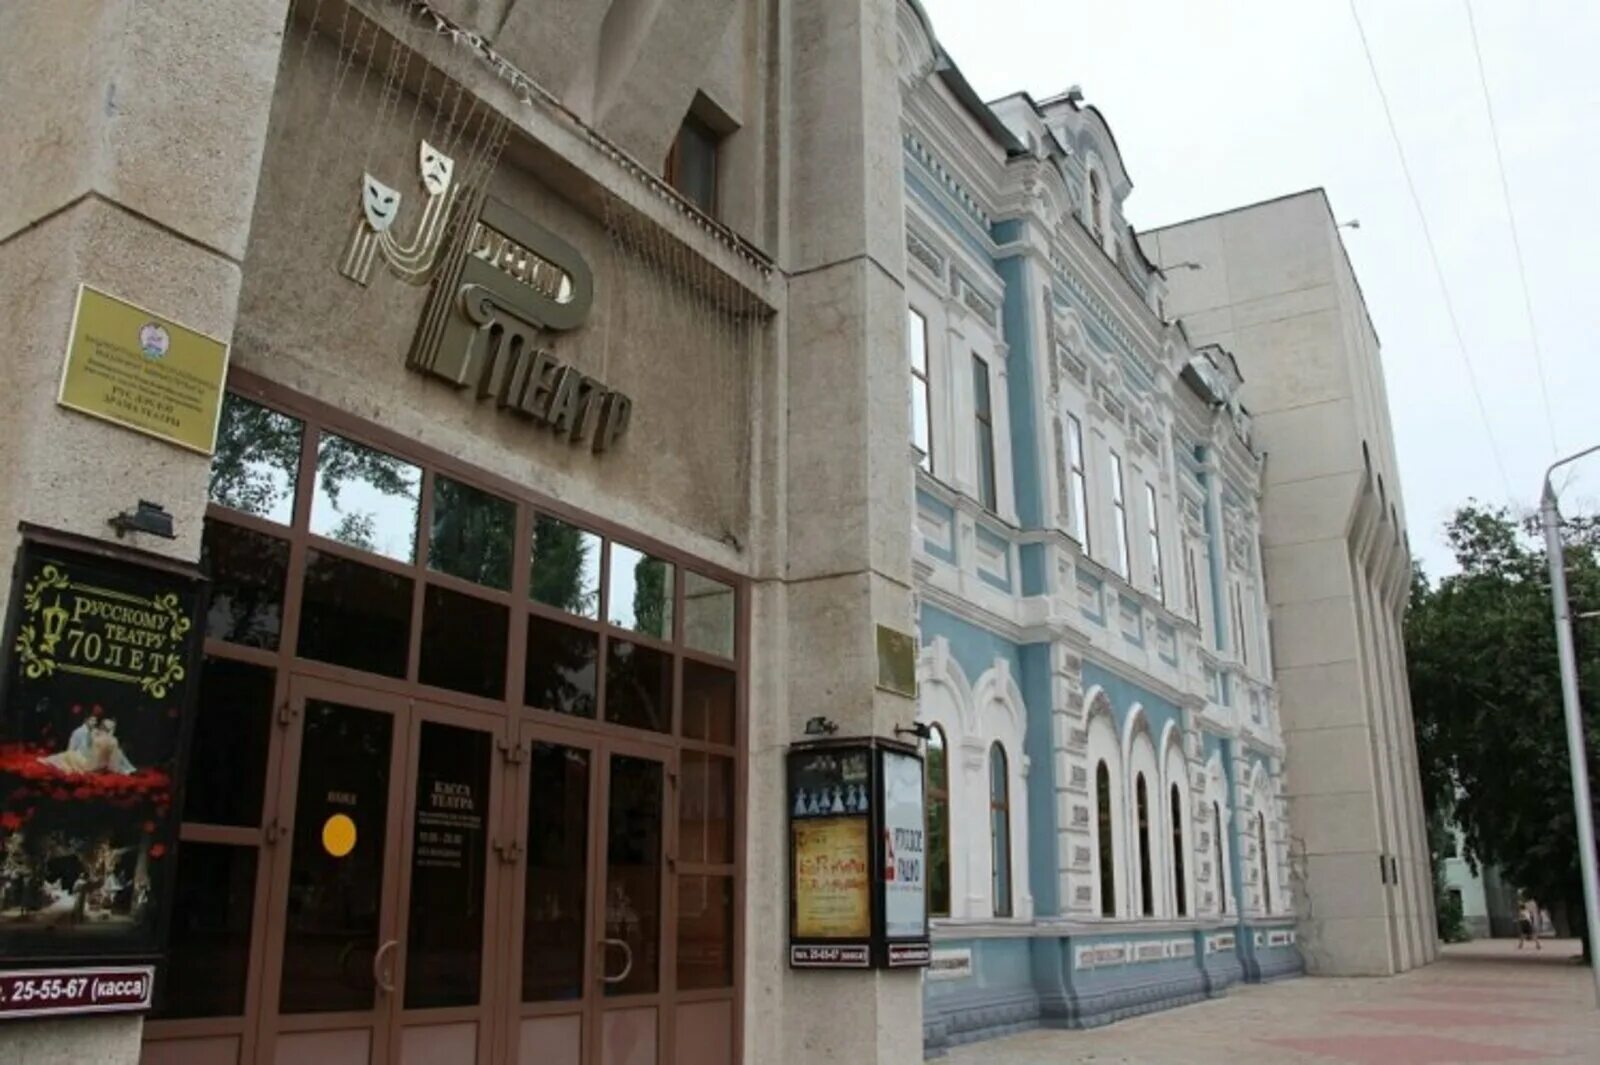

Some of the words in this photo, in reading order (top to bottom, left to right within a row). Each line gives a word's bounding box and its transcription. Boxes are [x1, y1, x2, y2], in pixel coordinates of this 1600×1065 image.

[72, 597, 169, 631] РУССКОМУ
[67, 629, 101, 662] 70
[104, 622, 168, 649] ТЕАТРУ
[12, 978, 88, 1001] 25-55-67
[91, 976, 148, 1002] (касса)
